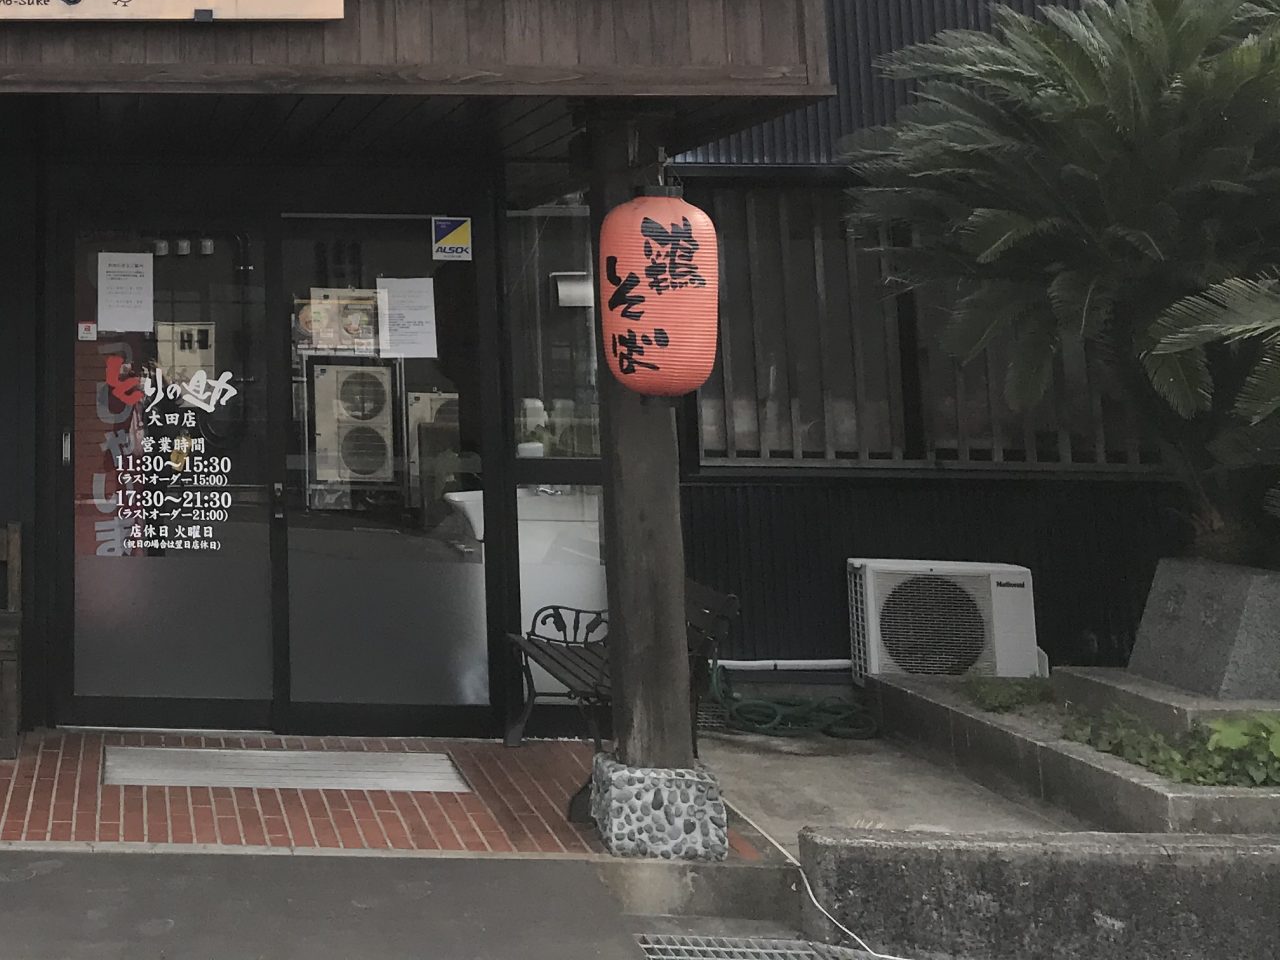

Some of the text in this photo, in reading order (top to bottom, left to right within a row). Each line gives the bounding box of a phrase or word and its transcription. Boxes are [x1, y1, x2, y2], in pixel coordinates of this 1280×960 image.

[435, 246, 470, 254] ALSOK
[106, 355, 238, 413] とりの助
[147, 411, 197, 428] 大田店
[140, 437, 205, 454] 営業時間
[130, 525, 213, 539] 店休日 火曜日
